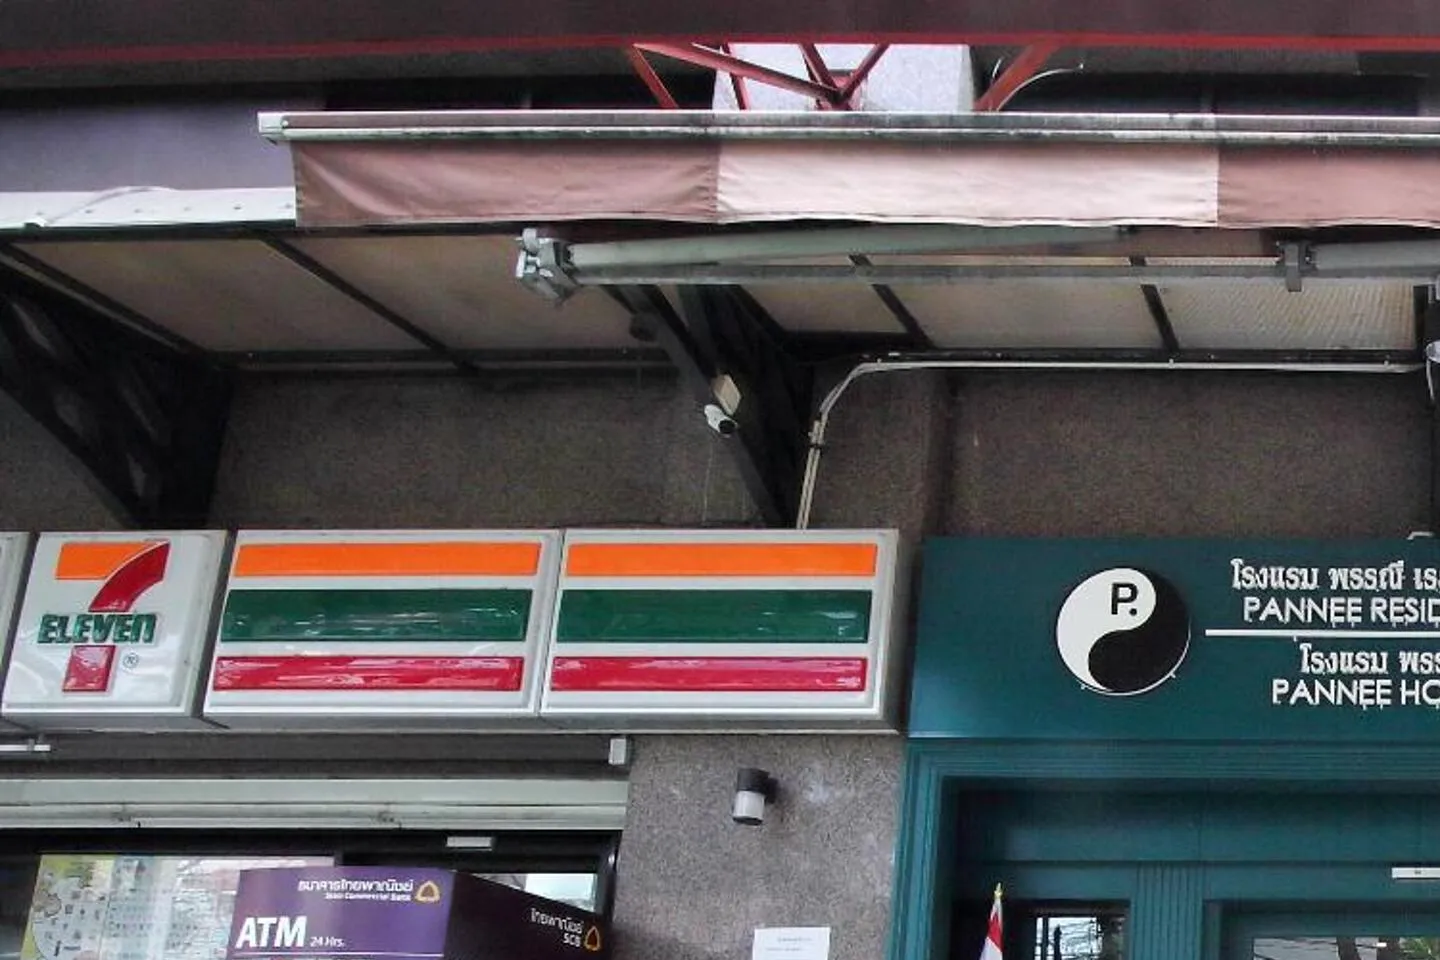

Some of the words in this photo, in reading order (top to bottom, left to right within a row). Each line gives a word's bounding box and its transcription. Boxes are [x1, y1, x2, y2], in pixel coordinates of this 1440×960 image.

[1230, 558, 1319, 590] โรงแรม
[1328, 560, 1405, 591] พรรณี
[54, 540, 171, 692] 7
[1243, 597, 1362, 625] PANNEE
[1300, 643, 1388, 675] โรงแรม
[1272, 679, 1392, 707] PANNEE
[235, 915, 307, 949] ATM
[310, 936, 323, 947] 24
